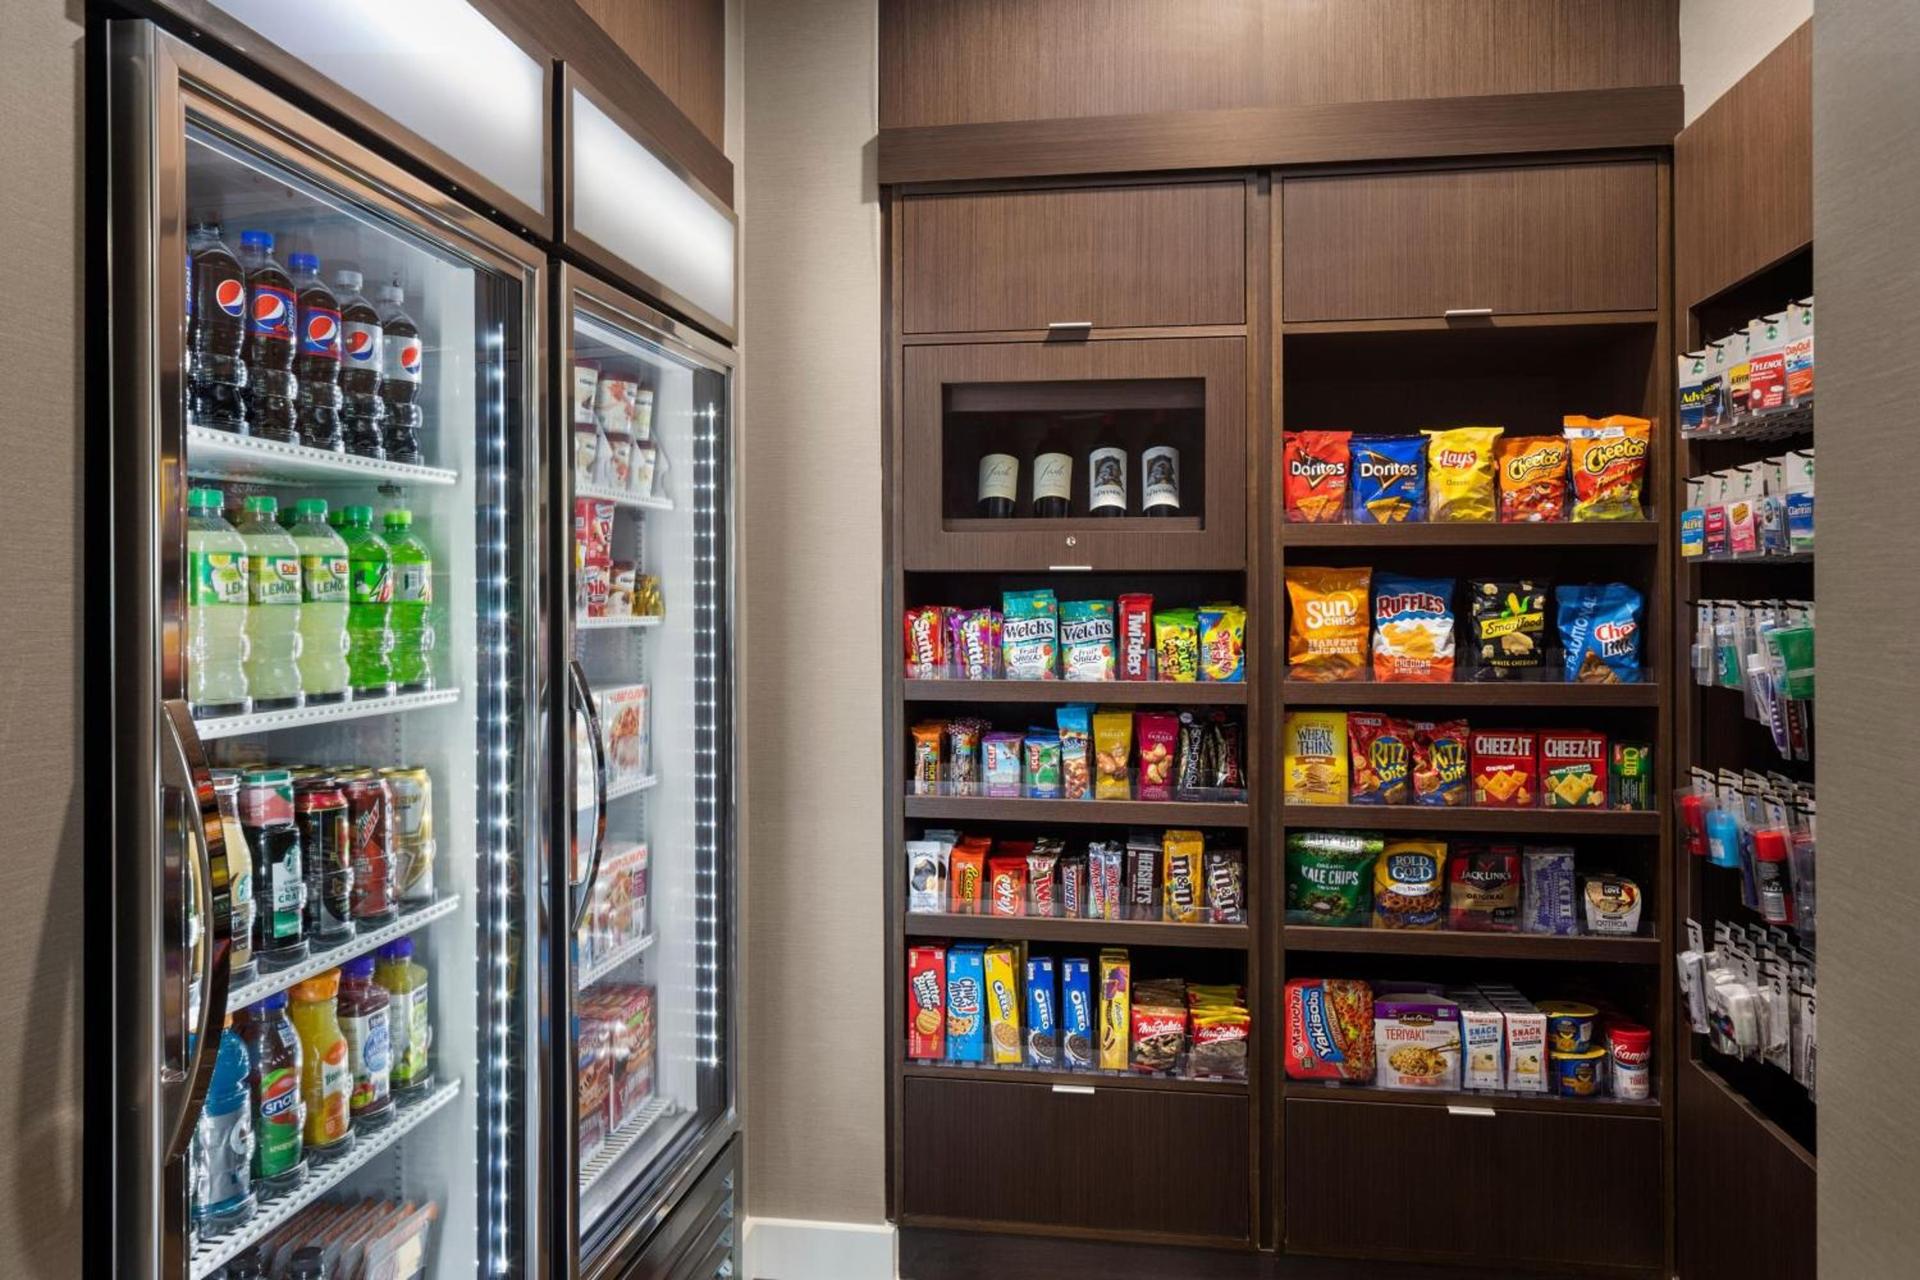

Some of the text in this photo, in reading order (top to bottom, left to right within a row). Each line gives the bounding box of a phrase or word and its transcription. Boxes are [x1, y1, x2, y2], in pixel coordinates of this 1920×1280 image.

[1681, 391, 1705, 403] Advi
[1441, 450, 1476, 468] Lay's
[1508, 448, 1561, 480] Cheetos
[1585, 438, 1647, 474] Cheetos
[1291, 460, 1345, 476] Doritos
[1360, 462, 1418, 477] Doritos
[1377, 593, 1445, 618] RUFFLES
[1004, 620, 1054, 639] Welch's
[1324, 616, 1356, 626] CHIPS
[1062, 621, 1112, 641] Welch's
[1308, 638, 1360, 646] HARVEST
[1163, 638, 1180, 675] PATCH
[1175, 637, 1192, 673] SOUR
[1394, 659, 1431, 669] CHEDDAR
[1297, 728, 1333, 742] WHEAT
[1299, 741, 1333, 756] THINS
[1371, 743, 1405, 768] RITZ
[1379, 765, 1407, 781] bits
[1395, 855, 1430, 866] ROLD
[1137, 853, 1154, 905] HERSHEY'S
[1301, 865, 1359, 886] KALE CHIPS
[1392, 865, 1433, 880] GOLD
[1461, 870, 1484, 881] JACK
[913, 976, 934, 1011] Butter
[922, 969, 941, 1006] Nutter
[959, 977, 976, 1007] Chips
[993, 980, 1009, 1020] OREO
[1034, 989, 1049, 1030] OREO
[1071, 990, 1086, 1031] OREO
[1291, 988, 1301, 1046] Maruchan
[1307, 990, 1330, 1057] Yakisoba
[1469, 1026, 1497, 1036] SNACK
[1512, 1027, 1541, 1038] SNACK
[1384, 1028, 1425, 1041] TERIYAKI
